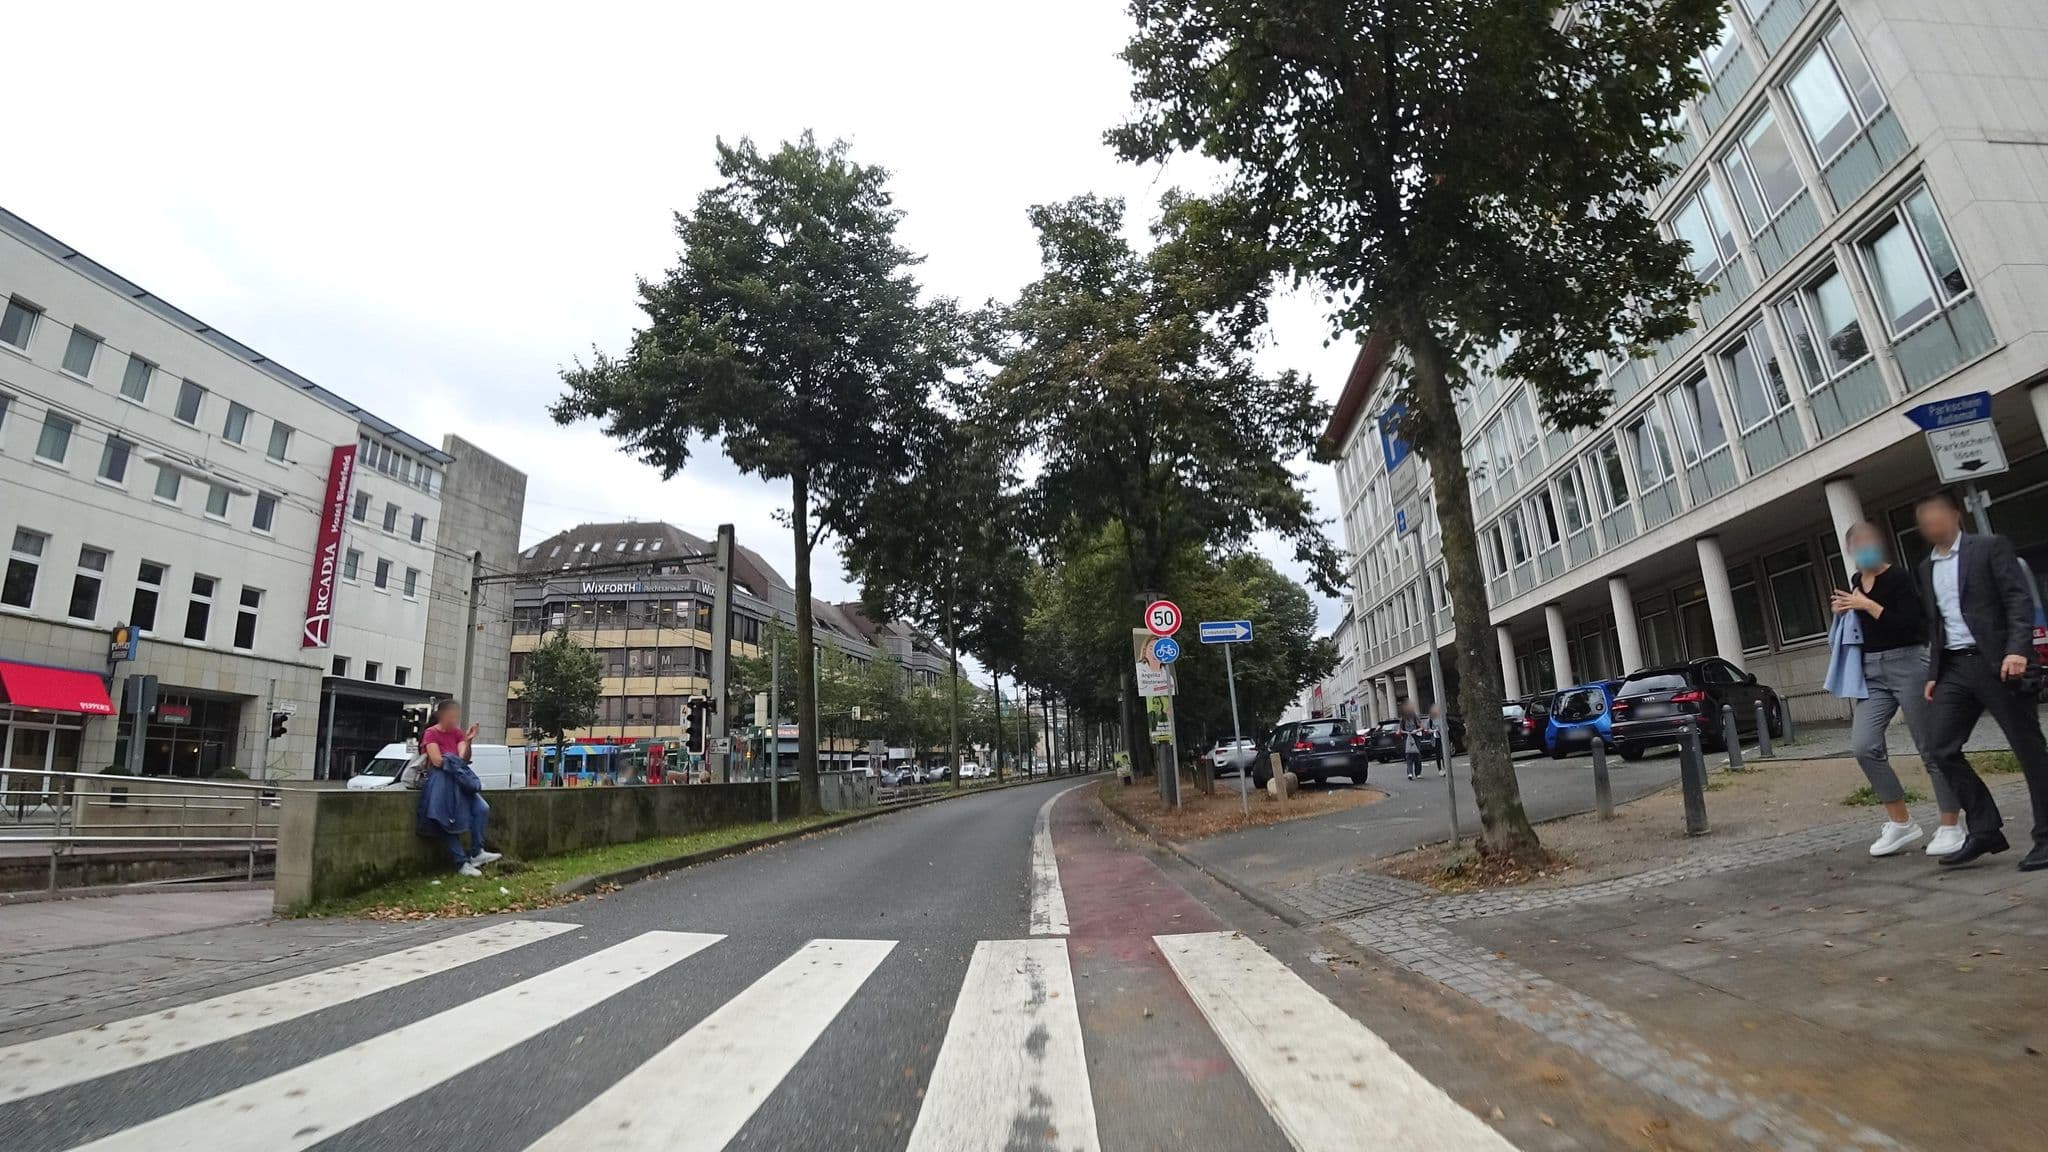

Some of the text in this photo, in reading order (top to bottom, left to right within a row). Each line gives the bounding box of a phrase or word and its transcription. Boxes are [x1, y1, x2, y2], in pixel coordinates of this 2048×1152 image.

[1949, 429, 1970, 438] Hier
[1935, 435, 1992, 451] Parkschein
[304, 543, 337, 647] ARCADIA
[331, 503, 342, 533] Hotel
[582, 581, 636, 593] WIXFORTH
[1154, 610, 1173, 627] 50
